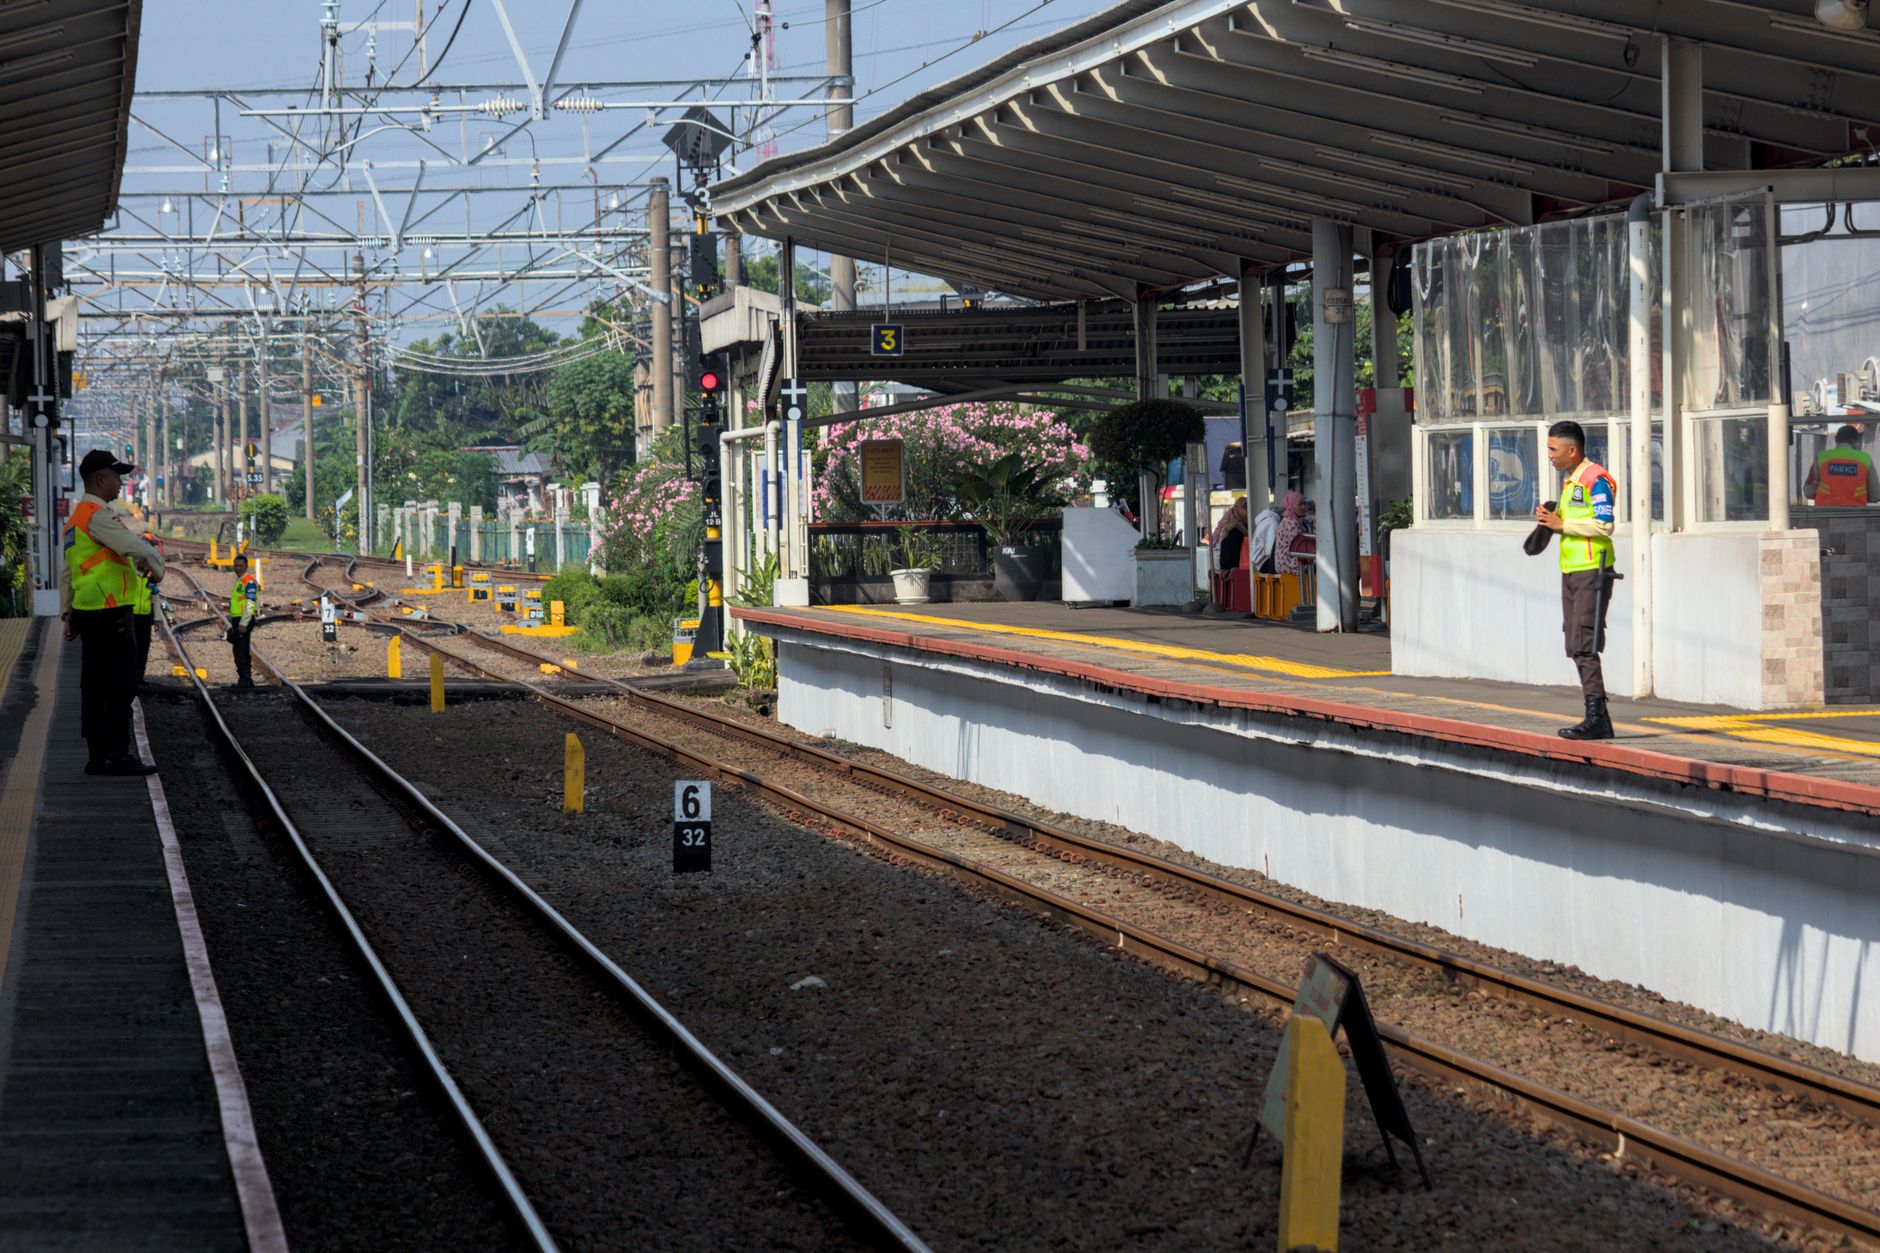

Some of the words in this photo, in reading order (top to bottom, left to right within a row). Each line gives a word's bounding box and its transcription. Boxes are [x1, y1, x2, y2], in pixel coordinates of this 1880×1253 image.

[880, 329, 896, 351] 3
[325, 608, 331, 618] 7
[324, 624, 335, 633] 32
[682, 784, 701, 819] 6
[682, 828, 706, 847] 32
